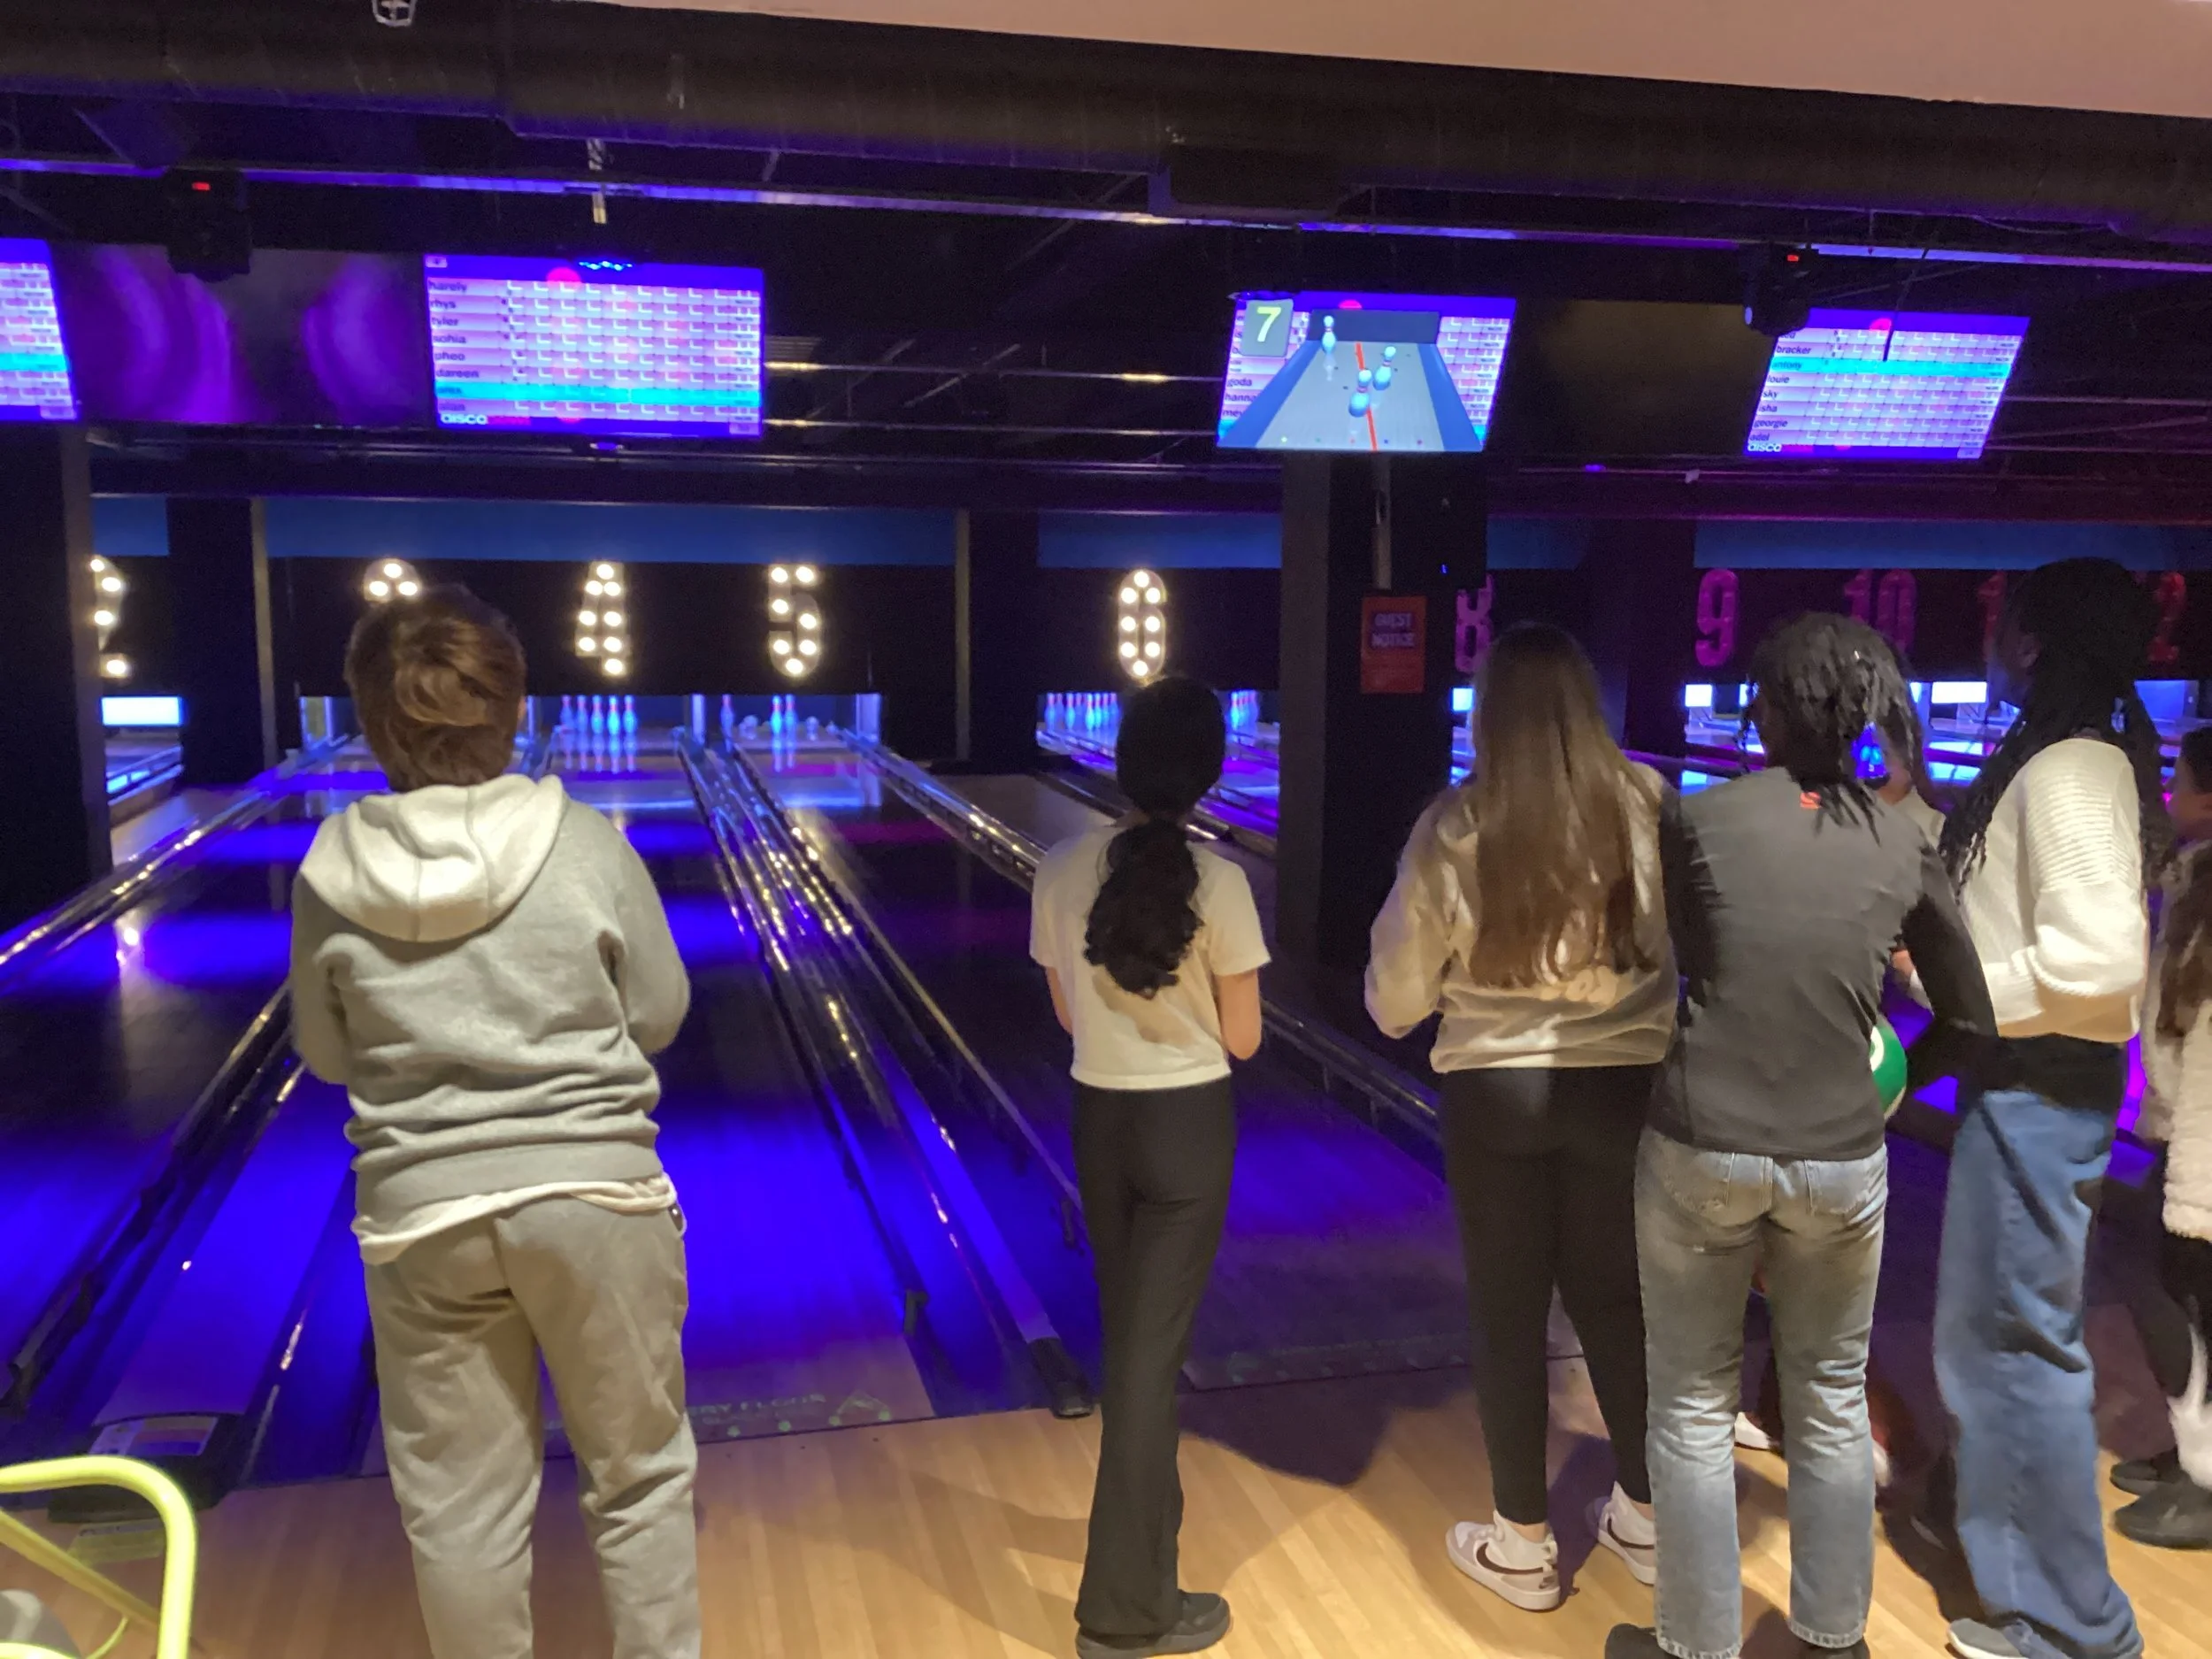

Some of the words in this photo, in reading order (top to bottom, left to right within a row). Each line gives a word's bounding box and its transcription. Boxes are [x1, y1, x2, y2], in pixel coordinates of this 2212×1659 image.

[1256, 306, 1282, 342] 7
[1777, 345, 1811, 355] bracker
[1227, 378, 1252, 388] goda
[575, 561, 633, 676] 4
[768, 563, 823, 678] 5
[1118, 569, 1167, 684] 6
[1371, 632, 1415, 649] NOTICE
[1375, 612, 1411, 627] GUEST
[1455, 572, 1493, 673] 8
[1695, 569, 1740, 667] 9
